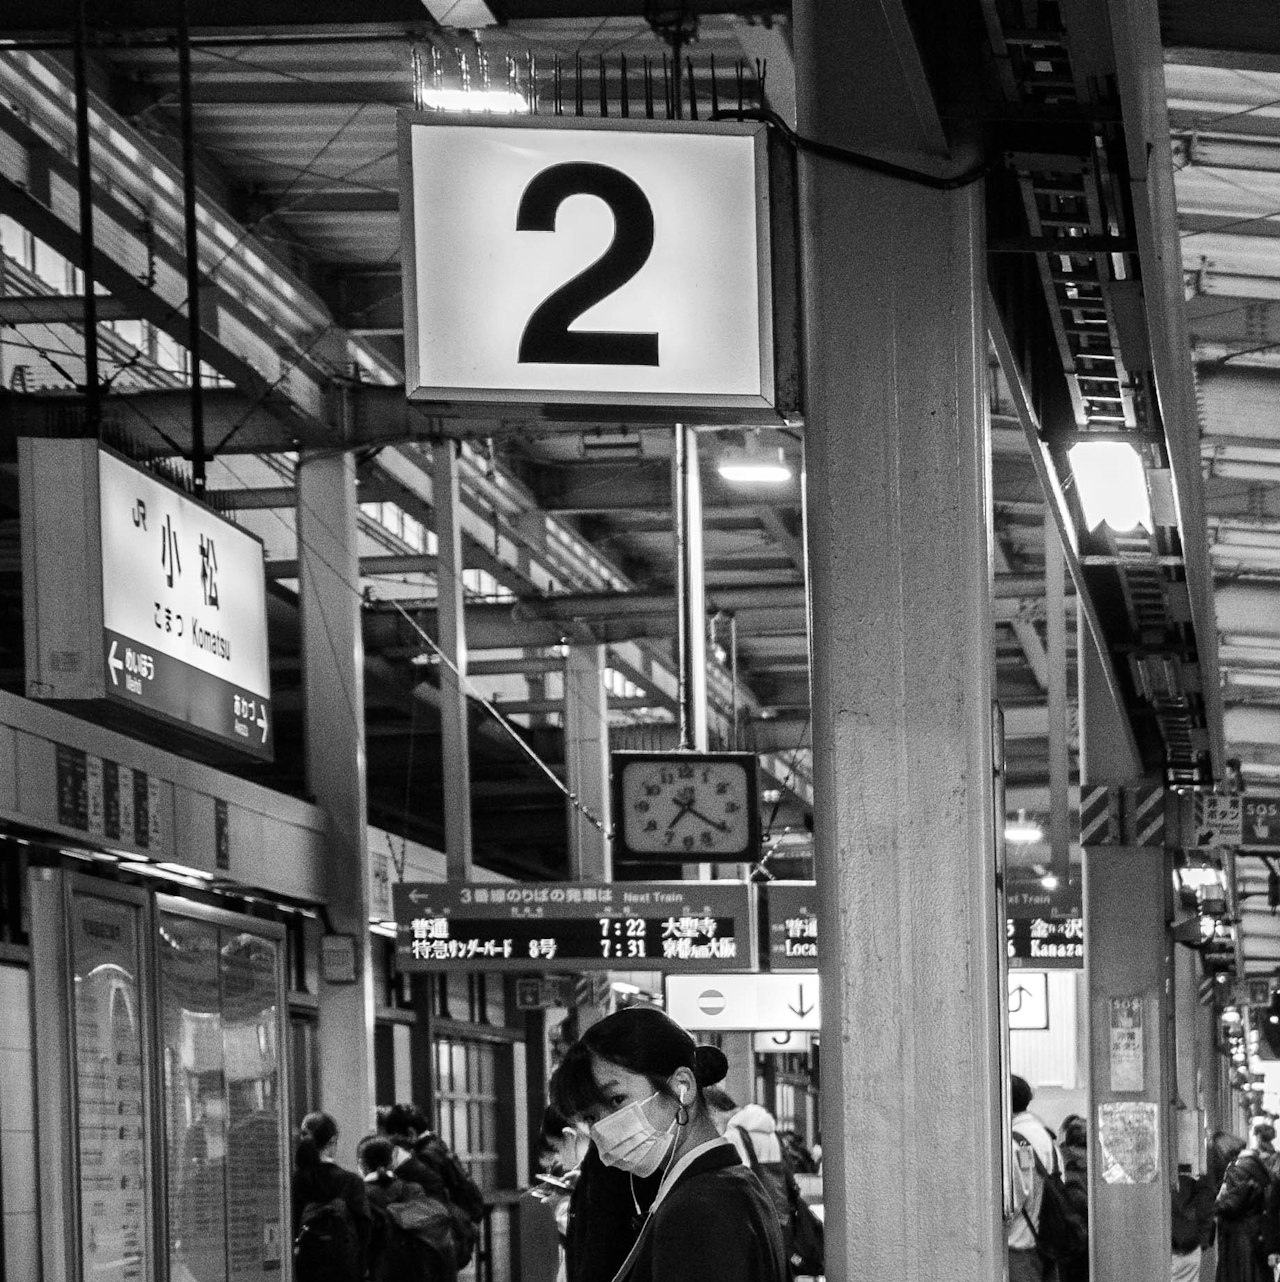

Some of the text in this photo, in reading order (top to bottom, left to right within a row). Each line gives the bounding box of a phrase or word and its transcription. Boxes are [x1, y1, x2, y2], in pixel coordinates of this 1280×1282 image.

[516, 161, 659, 366] 2
[161, 514, 220, 611] 小松
[154, 601, 231, 662] こまつ Komatsu
[1246, 803, 1277, 816] SOS
[411, 917, 449, 939] 普通
[599, 918, 646, 937] 7:22
[661, 917, 717, 938] 大聖寺
[600, 939, 646, 958] 7:31
[785, 939, 818, 957] Loca
[1030, 939, 1084, 958] Kanaza
